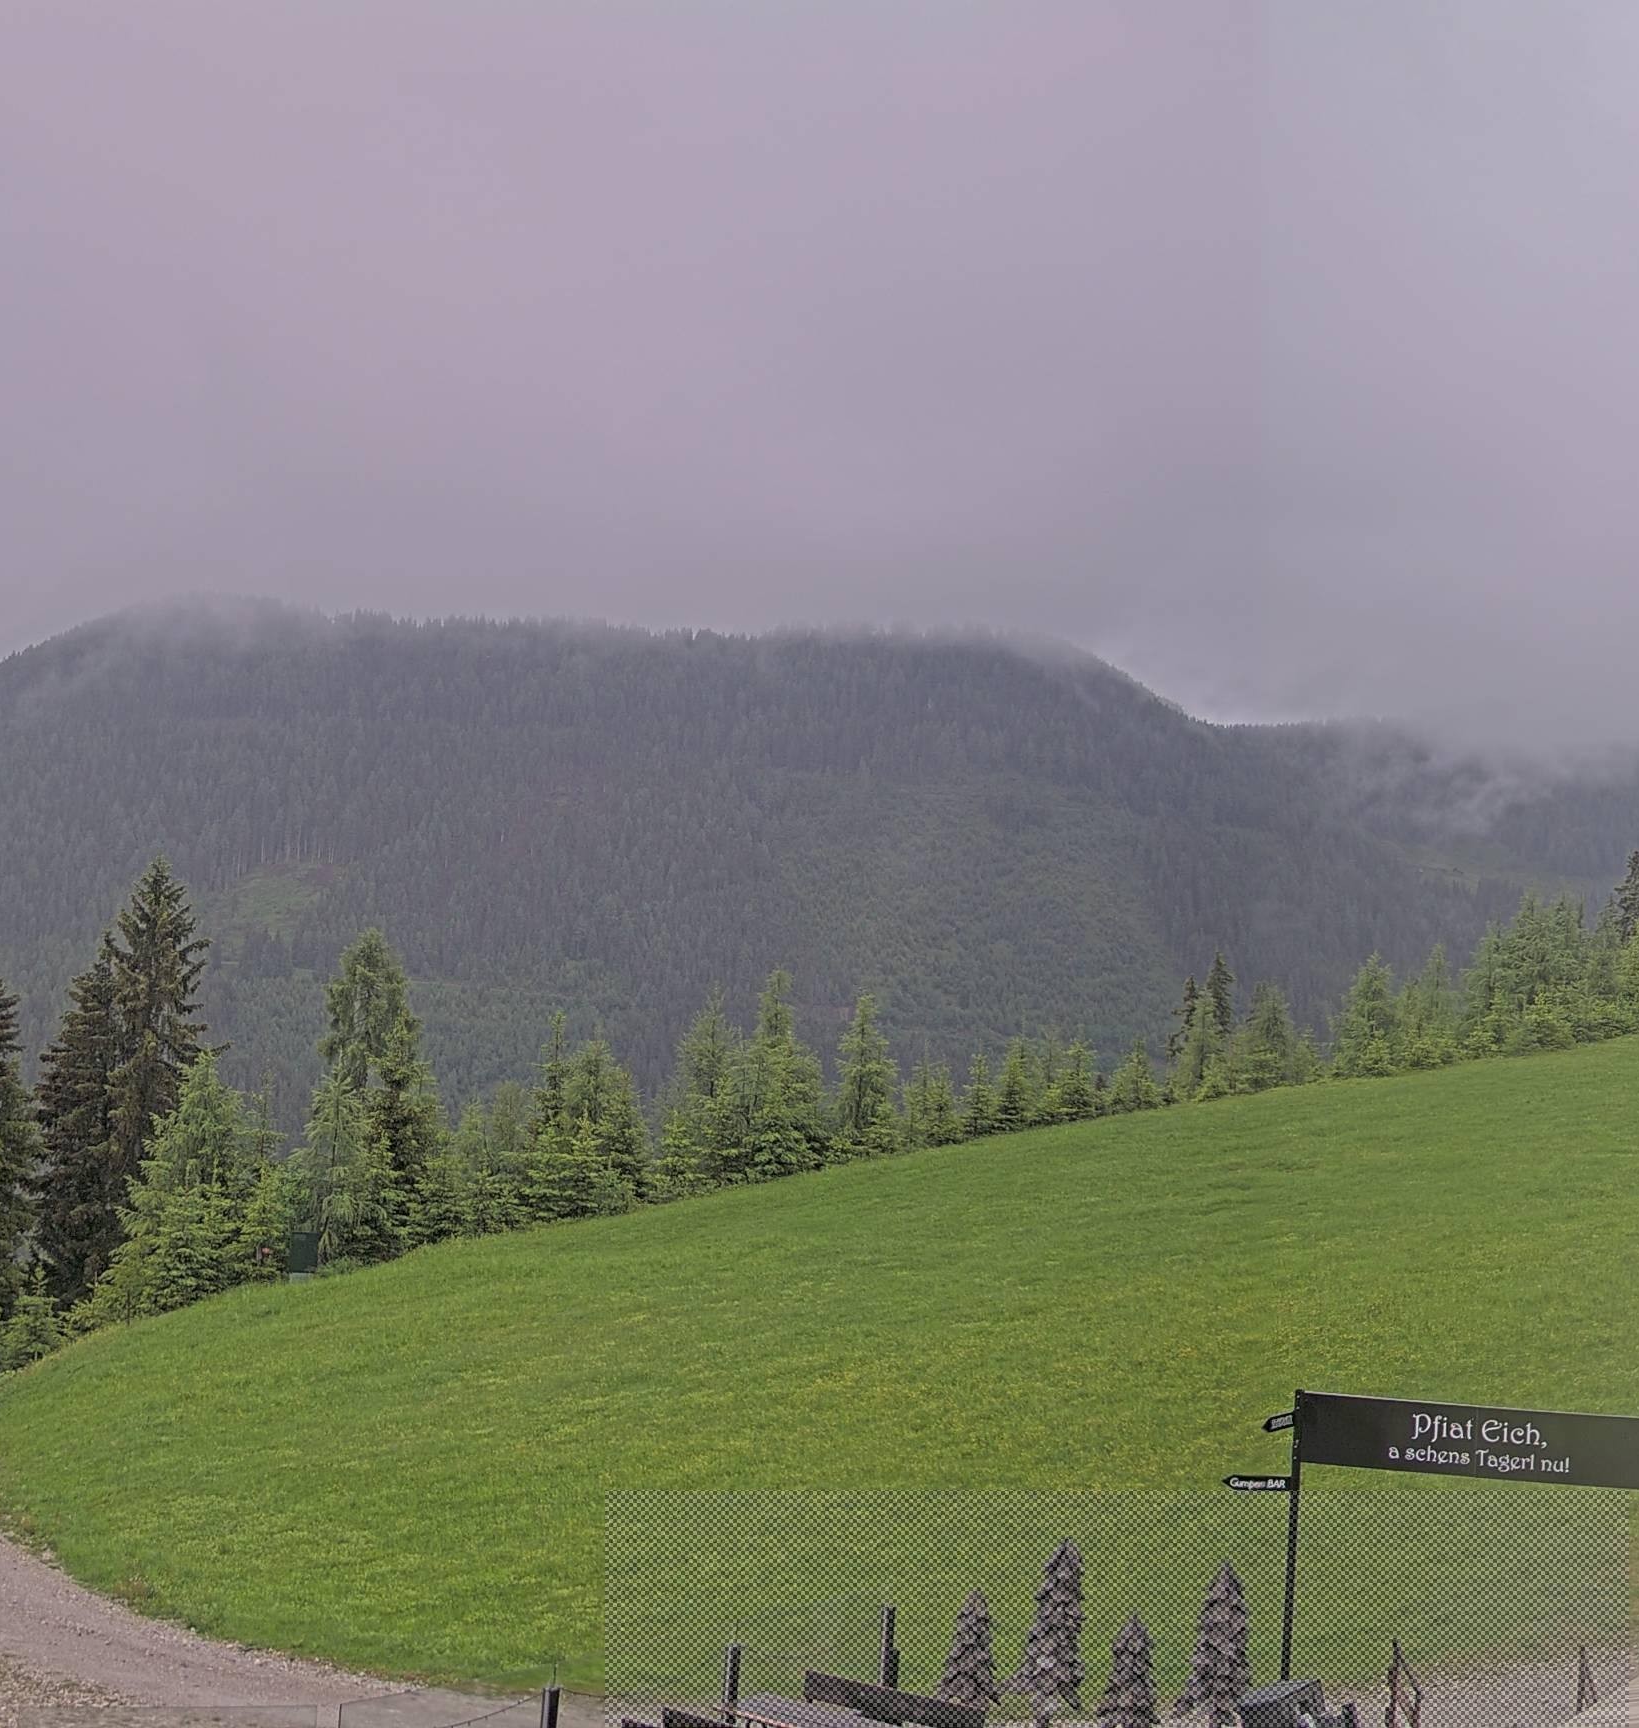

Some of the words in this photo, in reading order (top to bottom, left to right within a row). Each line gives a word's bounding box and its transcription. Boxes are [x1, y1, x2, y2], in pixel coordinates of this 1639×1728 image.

[1411, 1413, 1474, 1443] Pfiat
[1481, 1419, 1548, 1449] Eich,
[1388, 1446, 1400, 1460] a
[1404, 1445, 1471, 1465] schens
[1475, 1449, 1535, 1473] Tagerl
[1540, 1457, 1571, 1474] nu!
[1266, 1479, 1286, 1489] BAR
